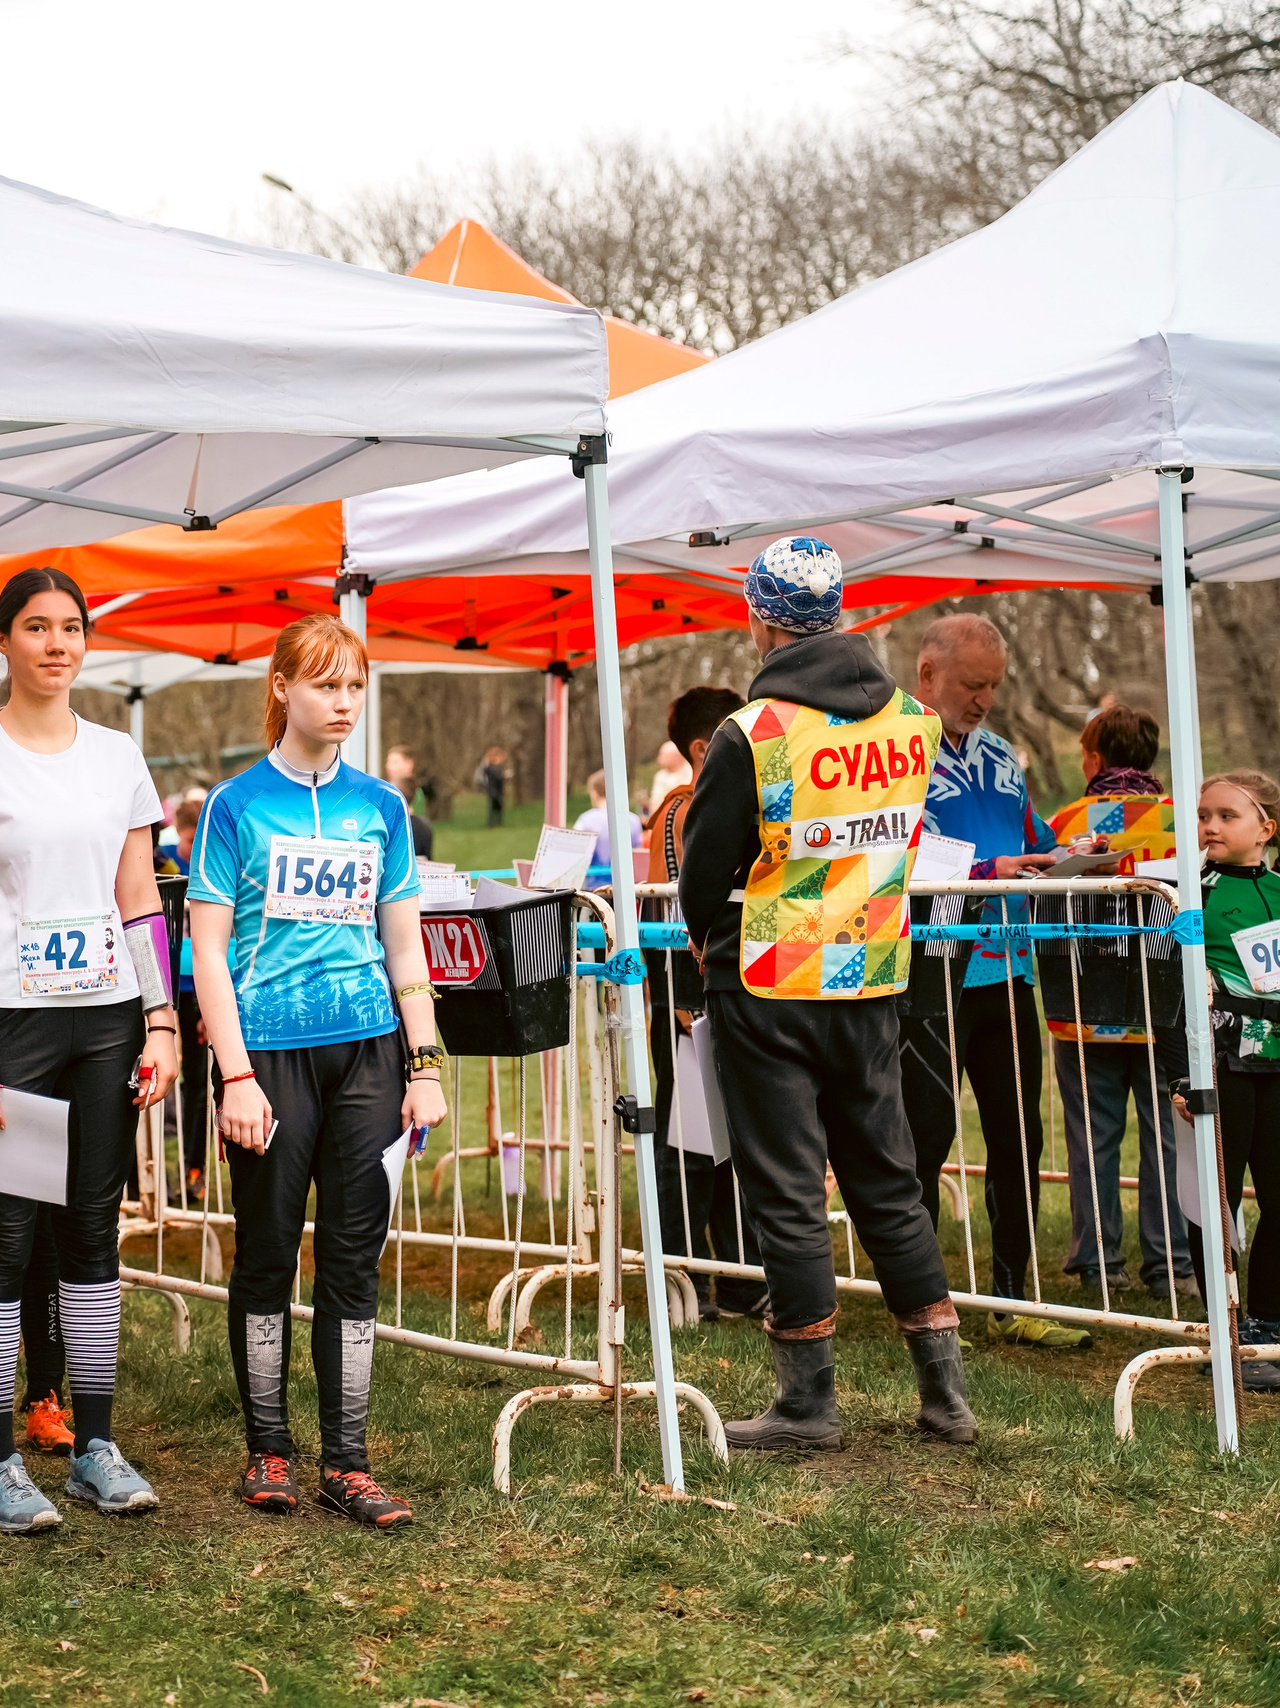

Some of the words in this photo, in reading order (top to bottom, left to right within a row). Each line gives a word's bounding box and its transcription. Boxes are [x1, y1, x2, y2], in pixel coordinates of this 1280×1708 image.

[810, 735, 926, 791] СУДЬЯ
[276, 855, 357, 899] 1564
[44, 930, 88, 971] 42
[421, 922, 480, 968] Ж21
